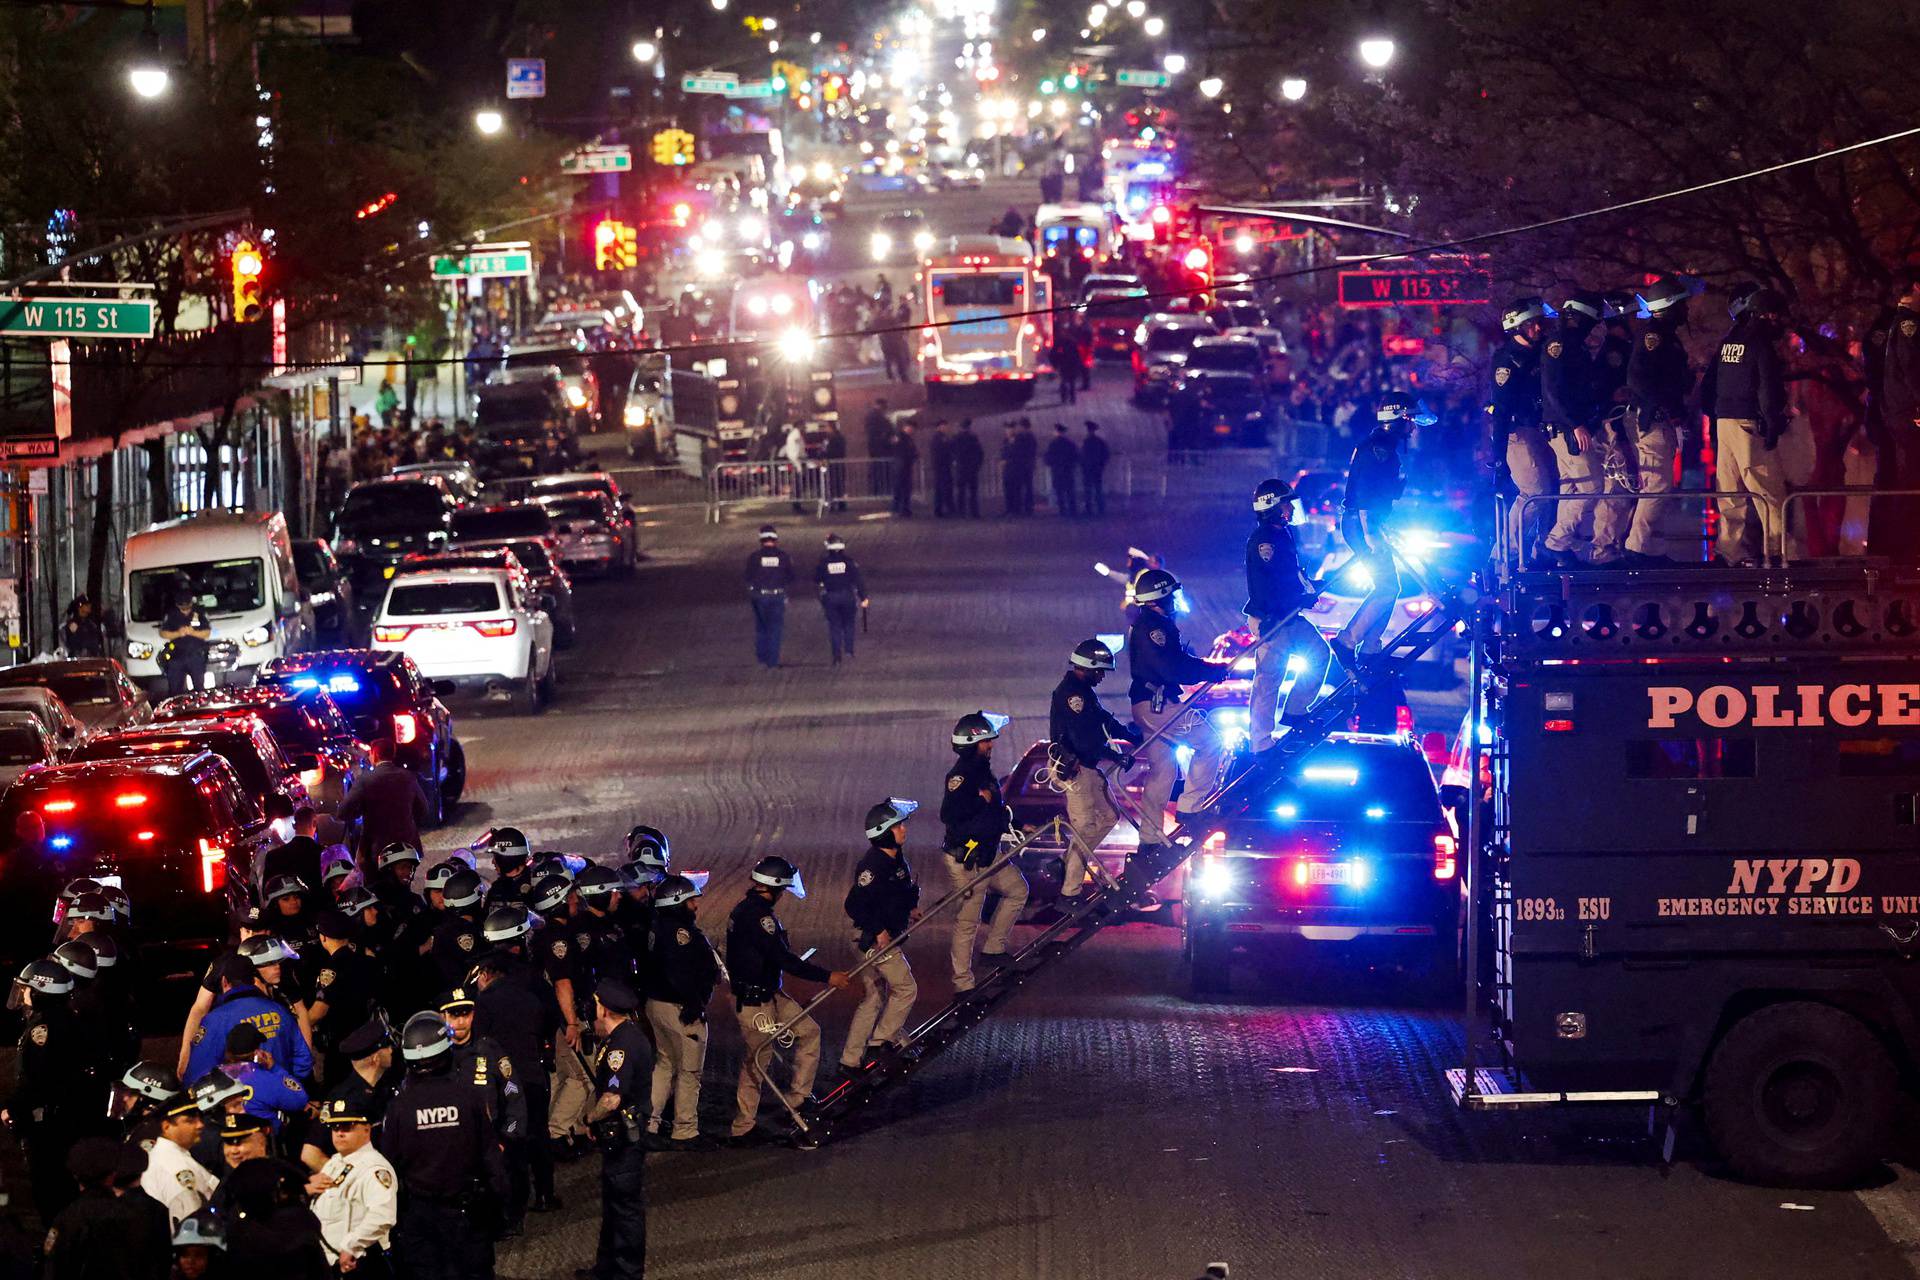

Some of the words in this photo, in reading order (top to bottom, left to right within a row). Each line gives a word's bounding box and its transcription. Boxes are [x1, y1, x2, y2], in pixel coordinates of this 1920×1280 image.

[1371, 278, 1391, 298] W
[1401, 278, 1431, 297] 115
[24, 306, 44, 327] W
[55, 307, 86, 328] 115
[97, 308, 118, 329] St
[1720, 343, 1745, 356] NYPD
[28, 443, 50, 454] WAY
[1647, 684, 1920, 728] POLICE
[1726, 858, 1861, 894] NYPD
[1578, 897, 1611, 920] ESU
[1657, 897, 1780, 916] EMERGENCY
[1788, 896, 1873, 915] SERVICE
[1881, 896, 1920, 914] UNI
[416, 1105, 459, 1125] NYPD
